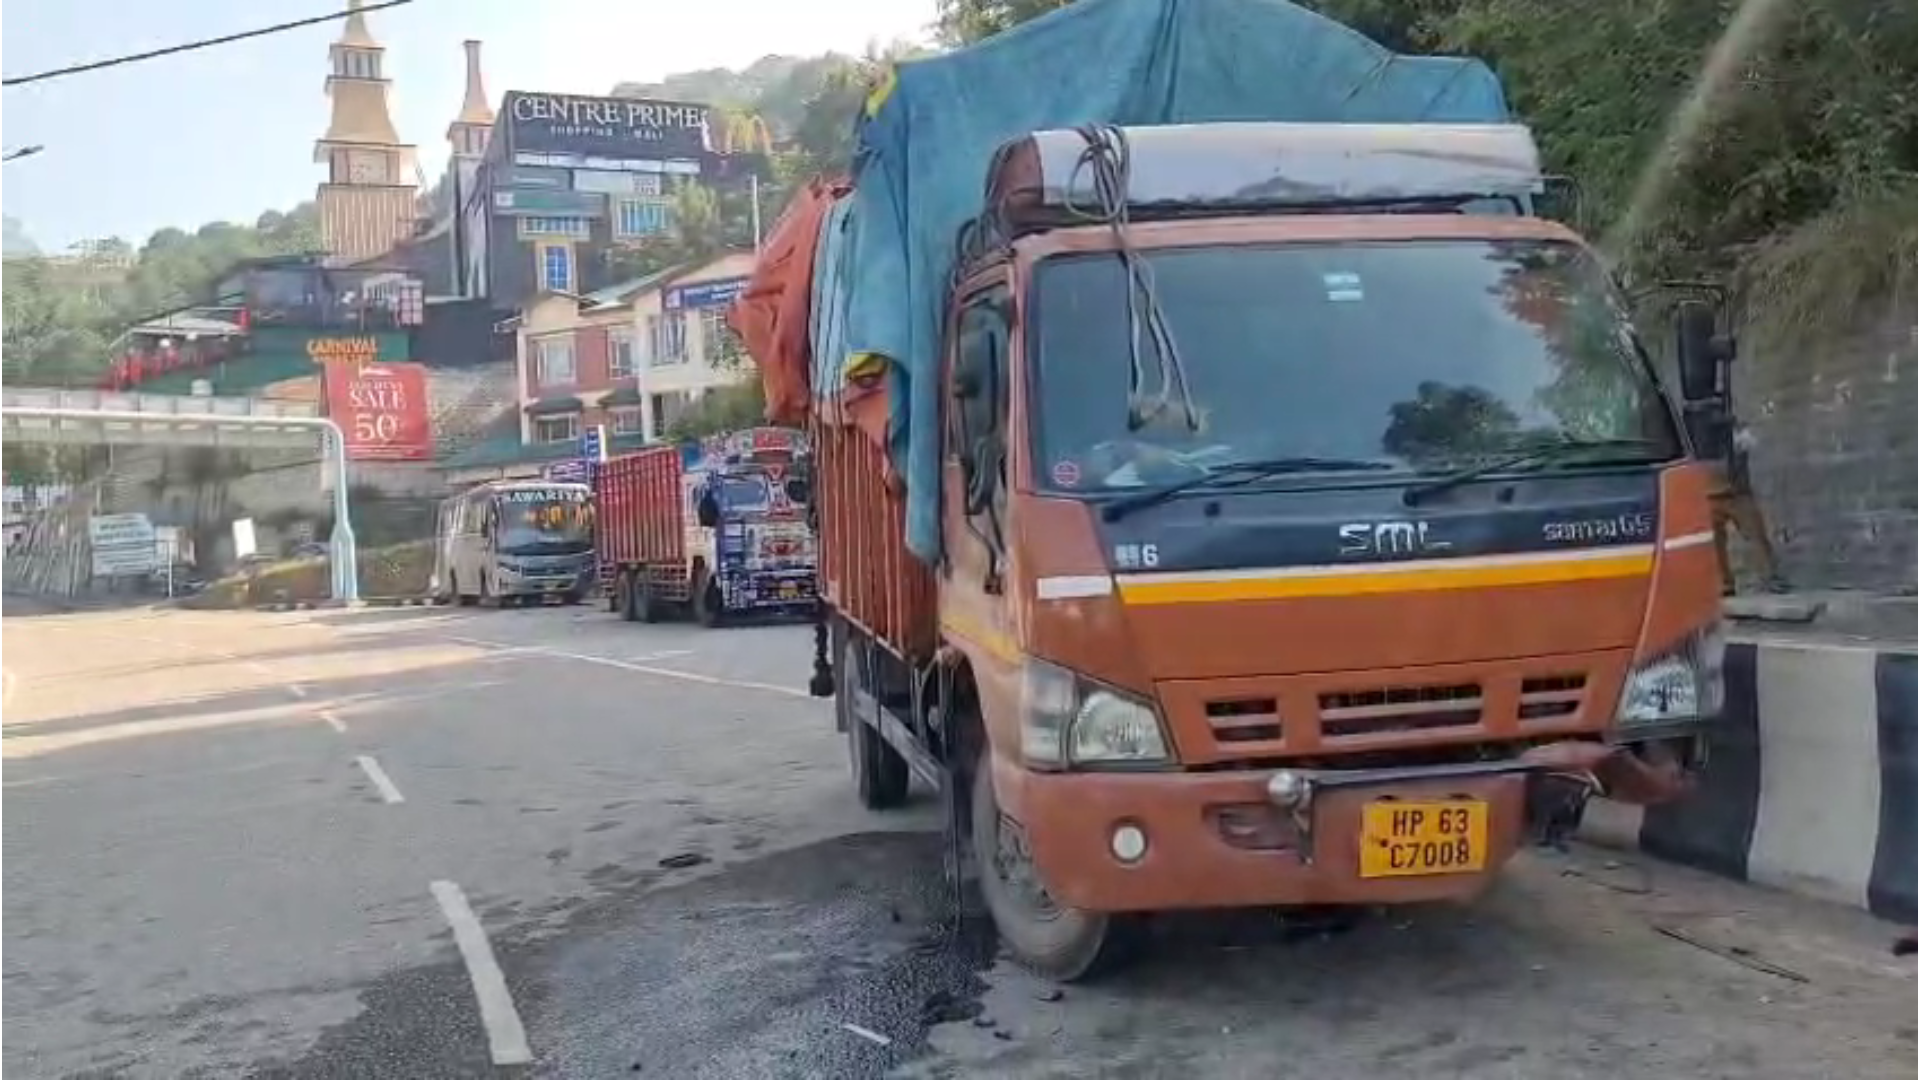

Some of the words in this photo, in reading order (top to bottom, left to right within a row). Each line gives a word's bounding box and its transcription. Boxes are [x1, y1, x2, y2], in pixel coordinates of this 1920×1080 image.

[513, 96, 621, 125] CENTRE
[627, 103, 704, 129] PRIME
[306, 336, 377, 355] CARNIVAL
[349, 388, 407, 411] SALE
[1339, 520, 1453, 555] SML
[1392, 809, 1425, 837] HP
[1438, 807, 1470, 835] 63
[1389, 836, 1470, 869] C7008
